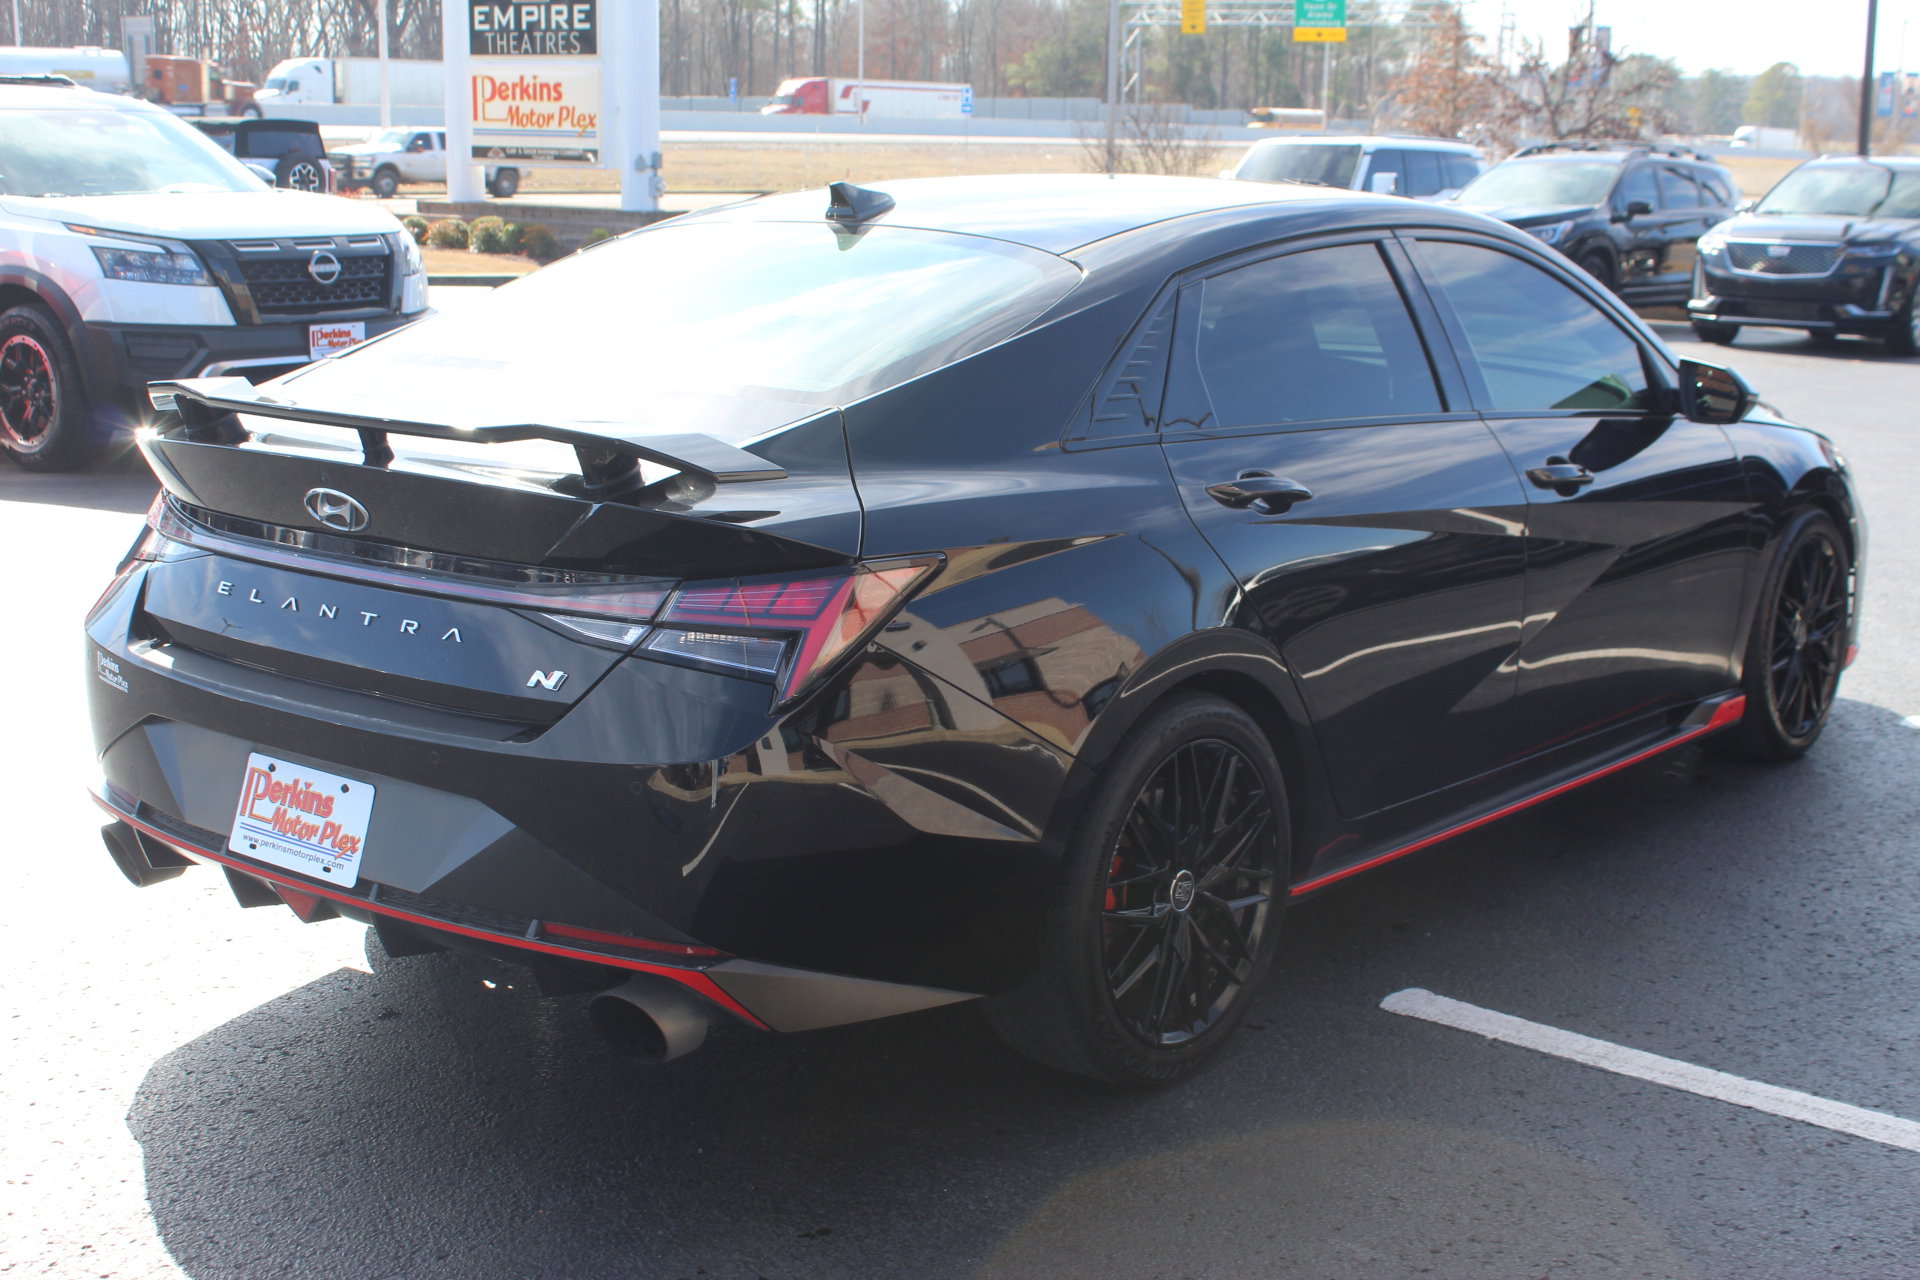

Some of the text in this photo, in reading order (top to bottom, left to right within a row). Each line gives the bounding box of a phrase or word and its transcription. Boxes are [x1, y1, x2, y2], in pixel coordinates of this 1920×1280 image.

[474, 4, 591, 31] EMPIRE
[485, 32, 581, 54] THEATRES
[472, 75, 563, 121] Perkins
[507, 105, 597, 138] Motor Plex
[312, 329, 351, 347] Perkins
[217, 581, 462, 643] ELANTRA
[97, 650, 119, 673] Perkins
[526, 669, 568, 692] N
[239, 766, 336, 818] Perkins
[272, 806, 361, 860] Motor Plex
[243, 833, 345, 870] www.perkinsmotorplex.com
